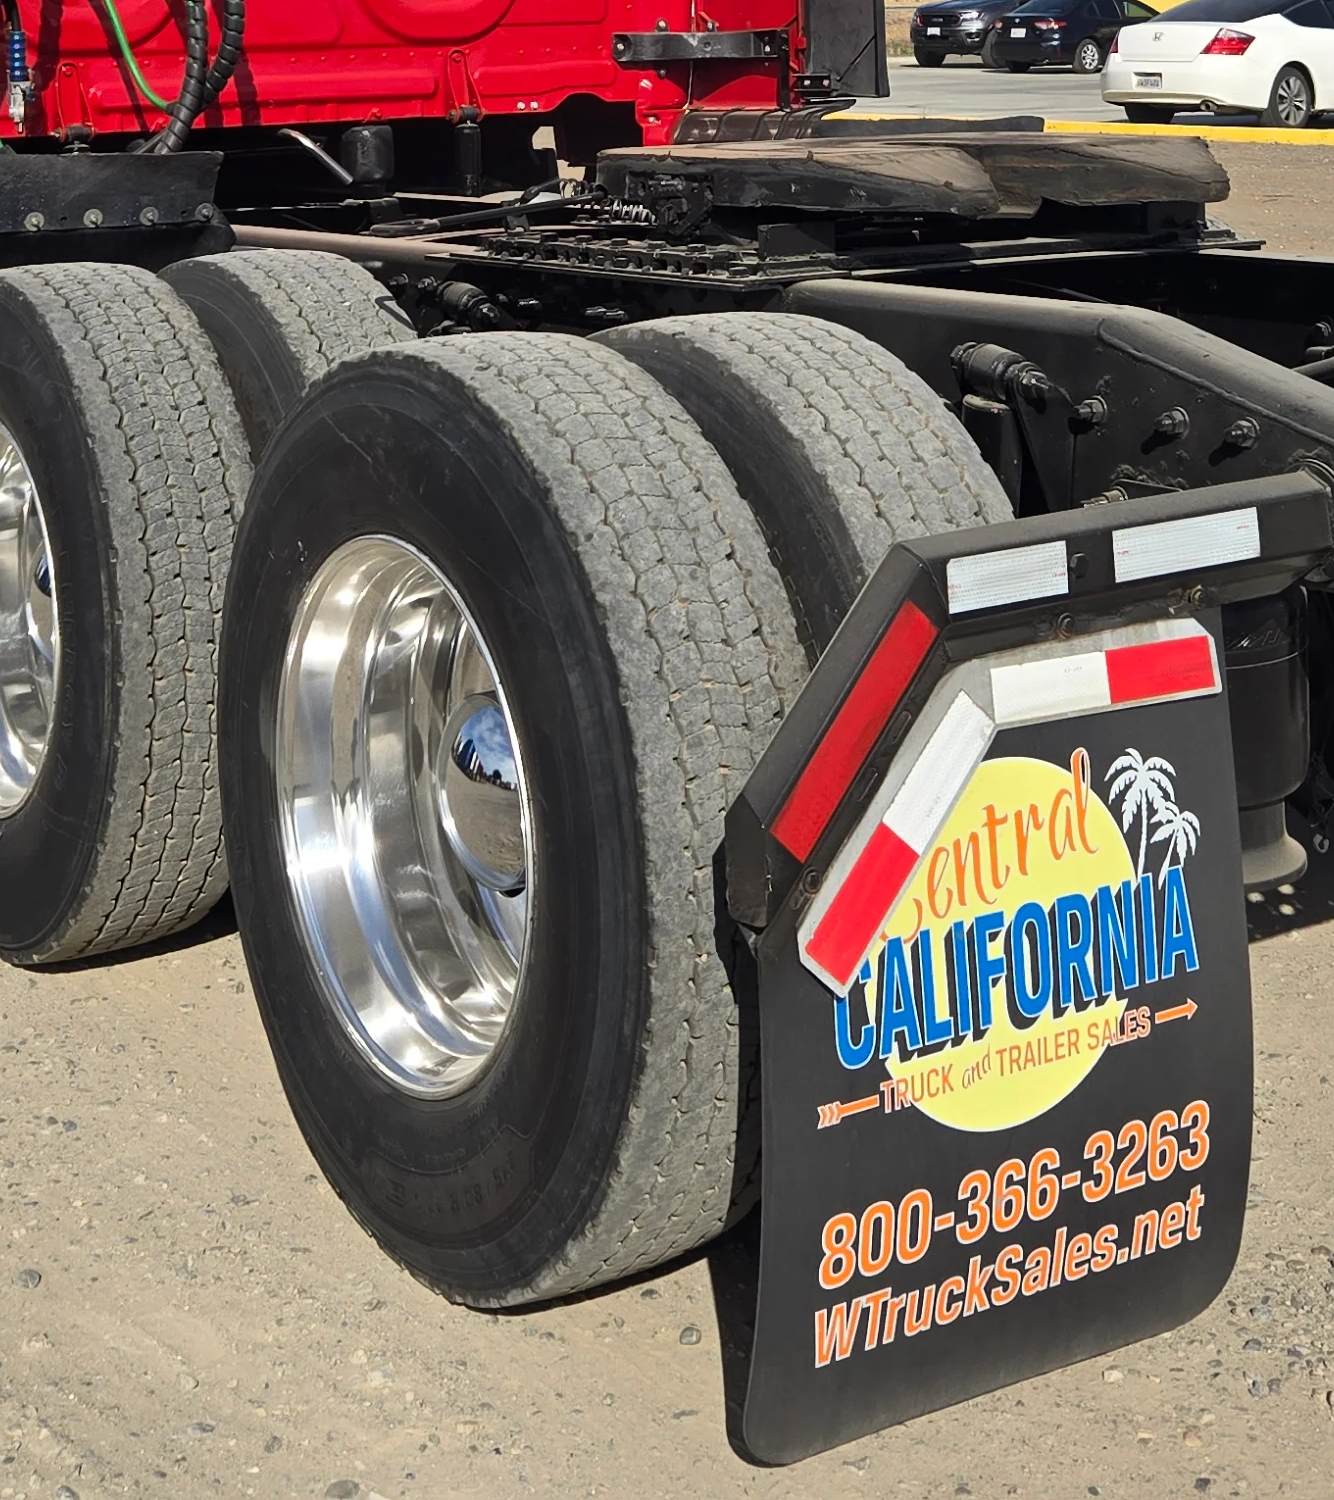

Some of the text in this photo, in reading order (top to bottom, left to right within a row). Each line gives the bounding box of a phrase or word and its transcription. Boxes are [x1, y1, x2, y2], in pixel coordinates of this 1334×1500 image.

[833, 864, 1200, 1070] CALIFORNIA
[880, 1006, 1152, 1113] TRUCK and TRAILER SALES
[814, 1184, 1205, 1368] WTruckSales.net
[818, 1099, 1210, 1289] 800-366-3263
